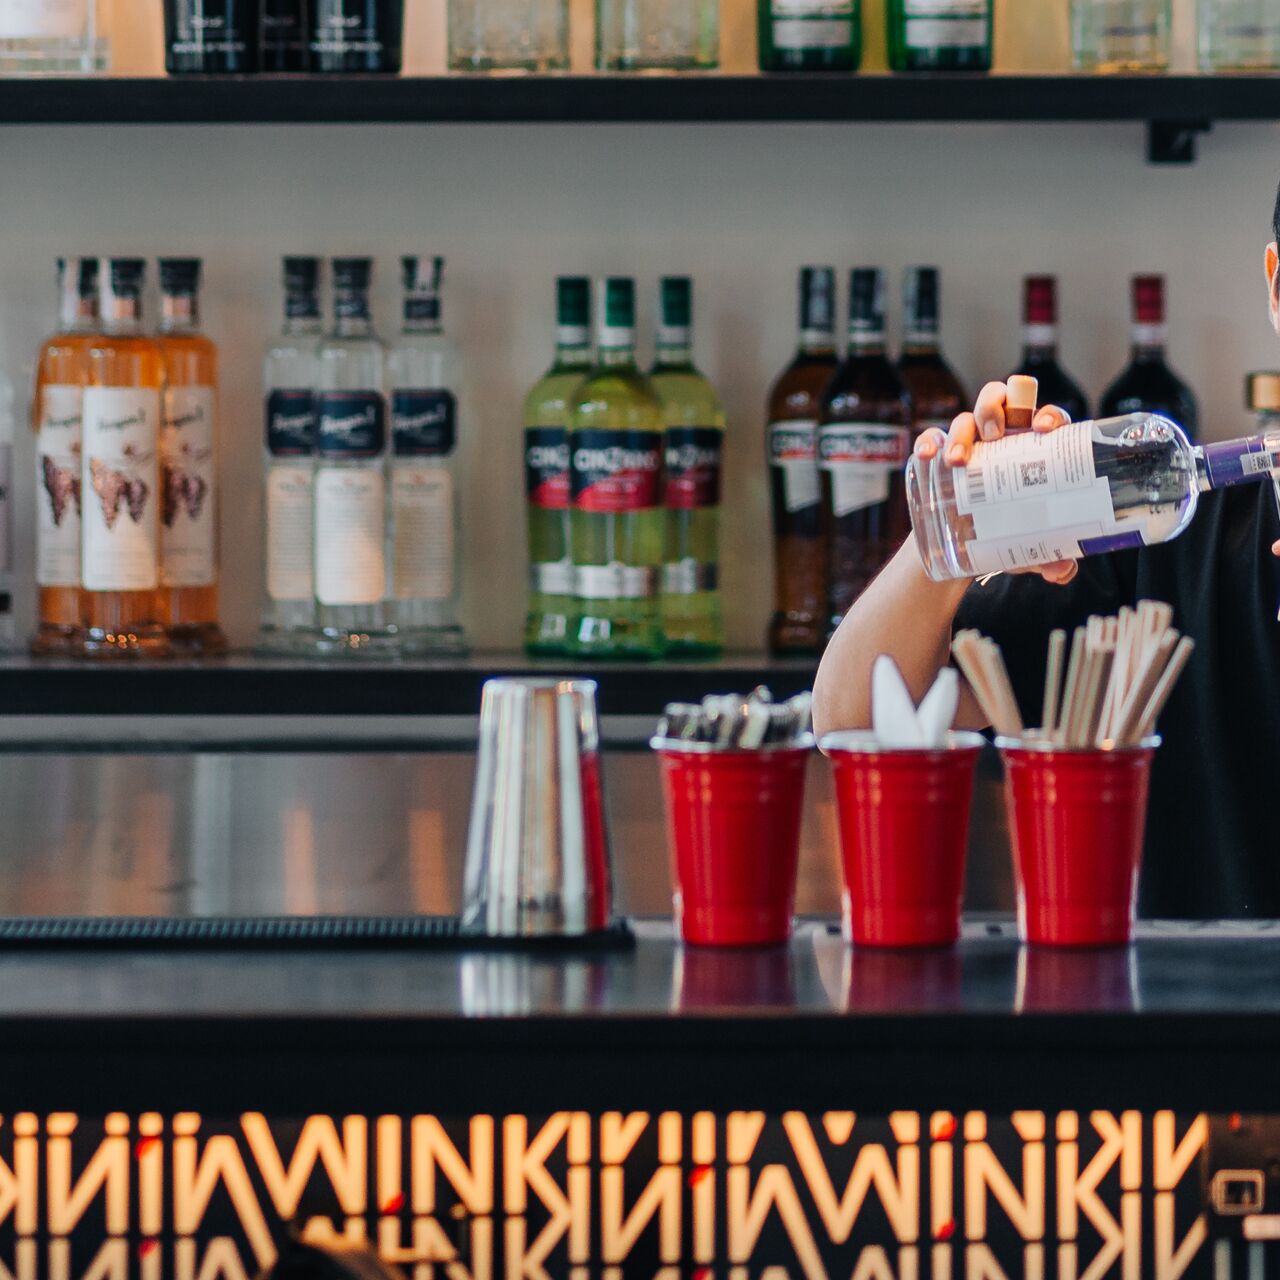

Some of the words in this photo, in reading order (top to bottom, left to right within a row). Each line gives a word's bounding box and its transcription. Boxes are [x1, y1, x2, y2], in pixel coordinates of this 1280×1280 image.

[574, 446, 659, 472] CINZANO
[240, 1112, 570, 1216] WINK
[784, 1117, 1122, 1242] WINK
